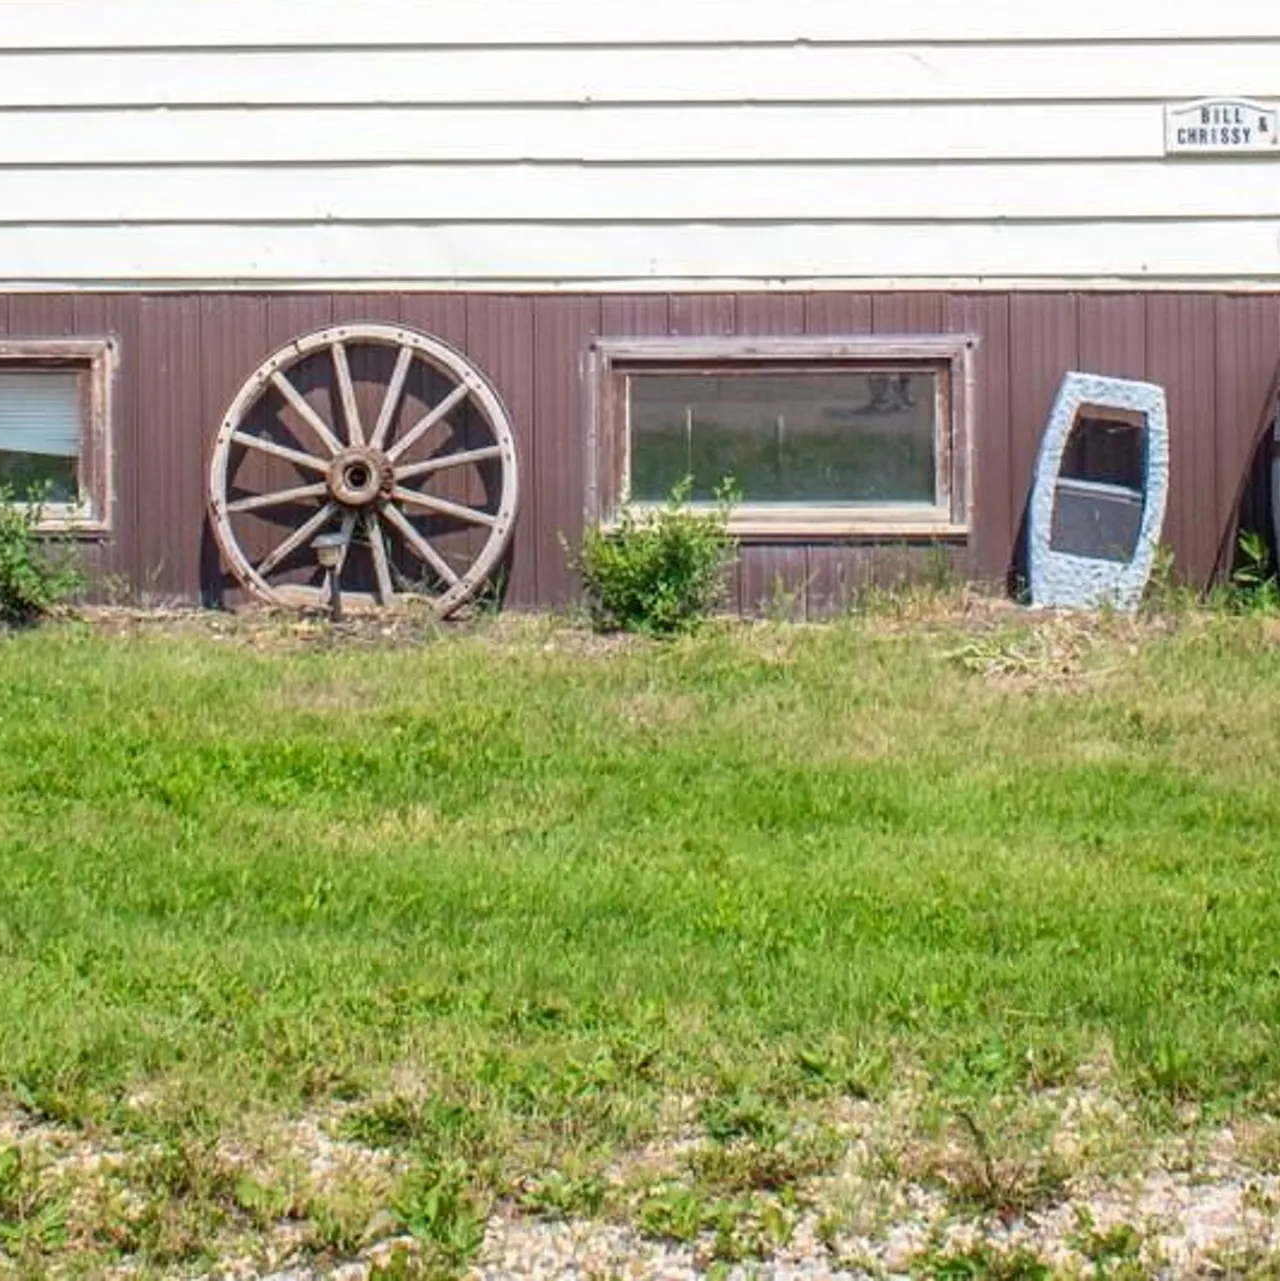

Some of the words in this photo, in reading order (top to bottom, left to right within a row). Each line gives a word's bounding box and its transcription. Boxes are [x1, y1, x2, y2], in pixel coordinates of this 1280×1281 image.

[1201, 107, 1242, 124] BILL
[1258, 116, 1268, 132] &
[1177, 127, 1251, 145] CHRISSY
